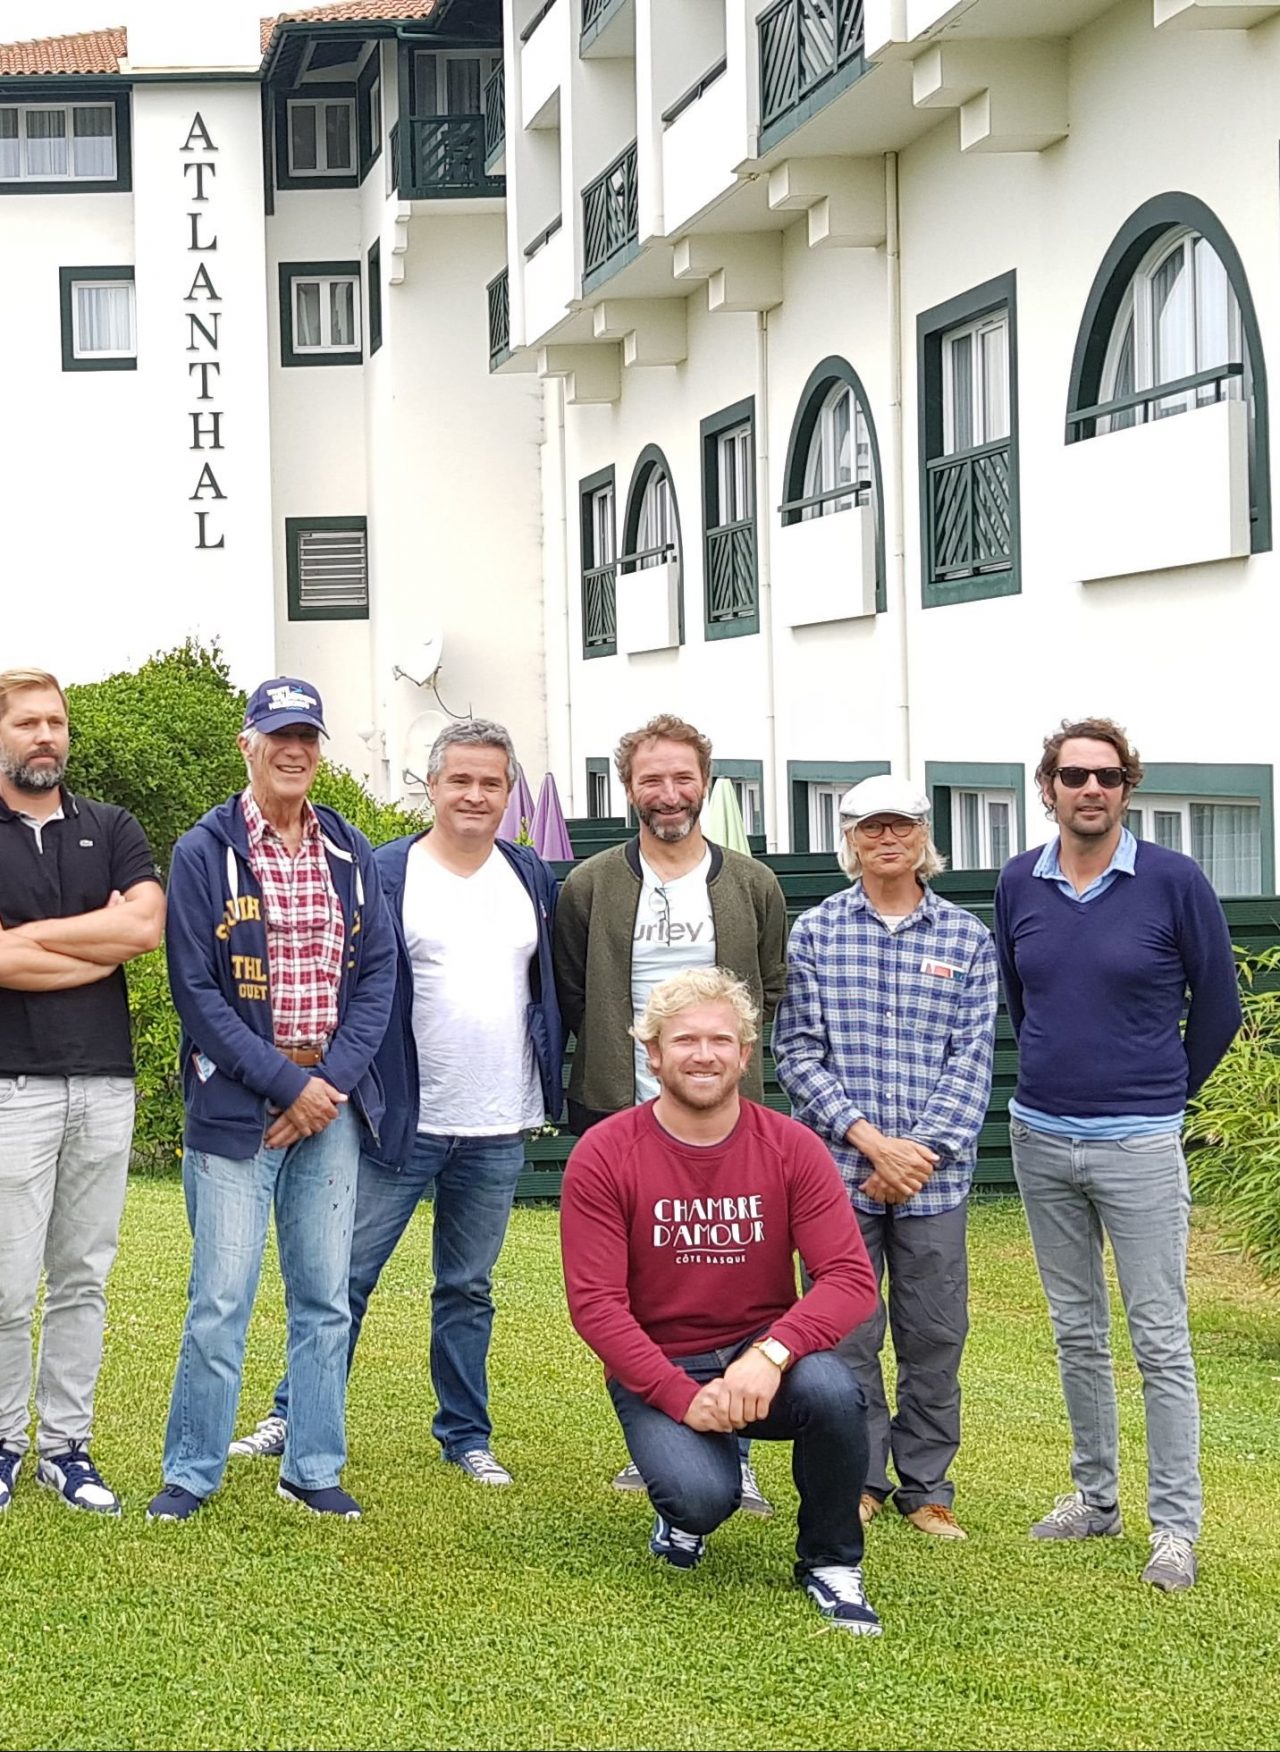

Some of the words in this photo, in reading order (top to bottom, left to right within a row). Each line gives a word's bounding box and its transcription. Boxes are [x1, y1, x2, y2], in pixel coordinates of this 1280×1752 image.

[179, 111, 227, 549] ATLANTHAL
[654, 1194, 764, 1222] CHAMBRE
[653, 1221, 765, 1247] D'AMOUR
[675, 1253, 701, 1264] CÔTE
[706, 1255, 746, 1265] BASQUE
